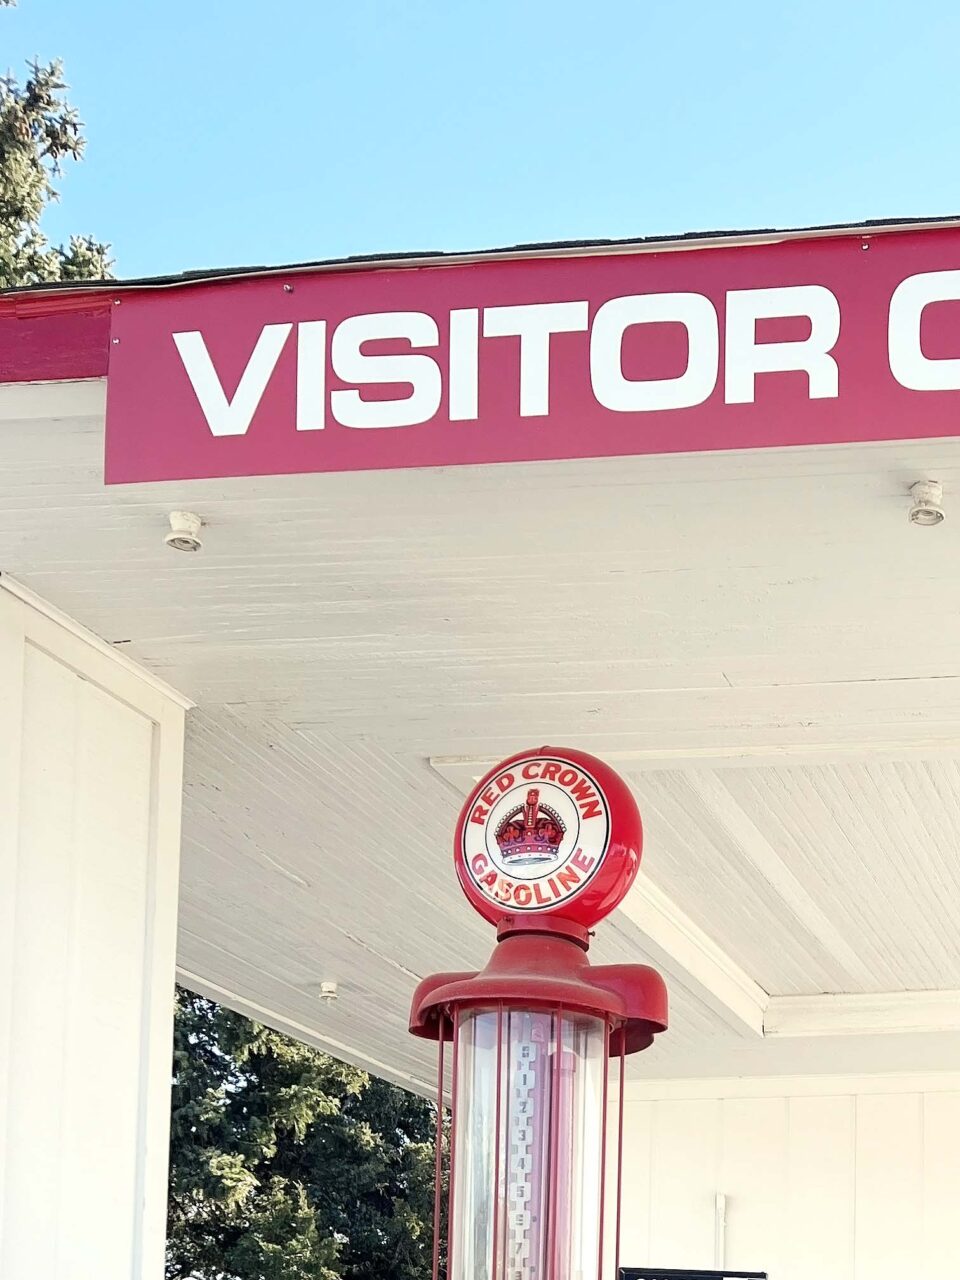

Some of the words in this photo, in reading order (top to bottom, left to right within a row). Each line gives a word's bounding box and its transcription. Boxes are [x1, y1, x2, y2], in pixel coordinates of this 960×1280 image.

[172, 284, 842, 438] VISITOR
[471, 773, 515, 825] RED
[521, 763, 602, 820] CROWN
[471, 848, 595, 905] GASOLINE
[519, 1101, 527, 1113] 2
[519, 1130, 526, 1141] 3
[517, 1158, 525, 1170] 4
[515, 1243, 522, 1254] 7
